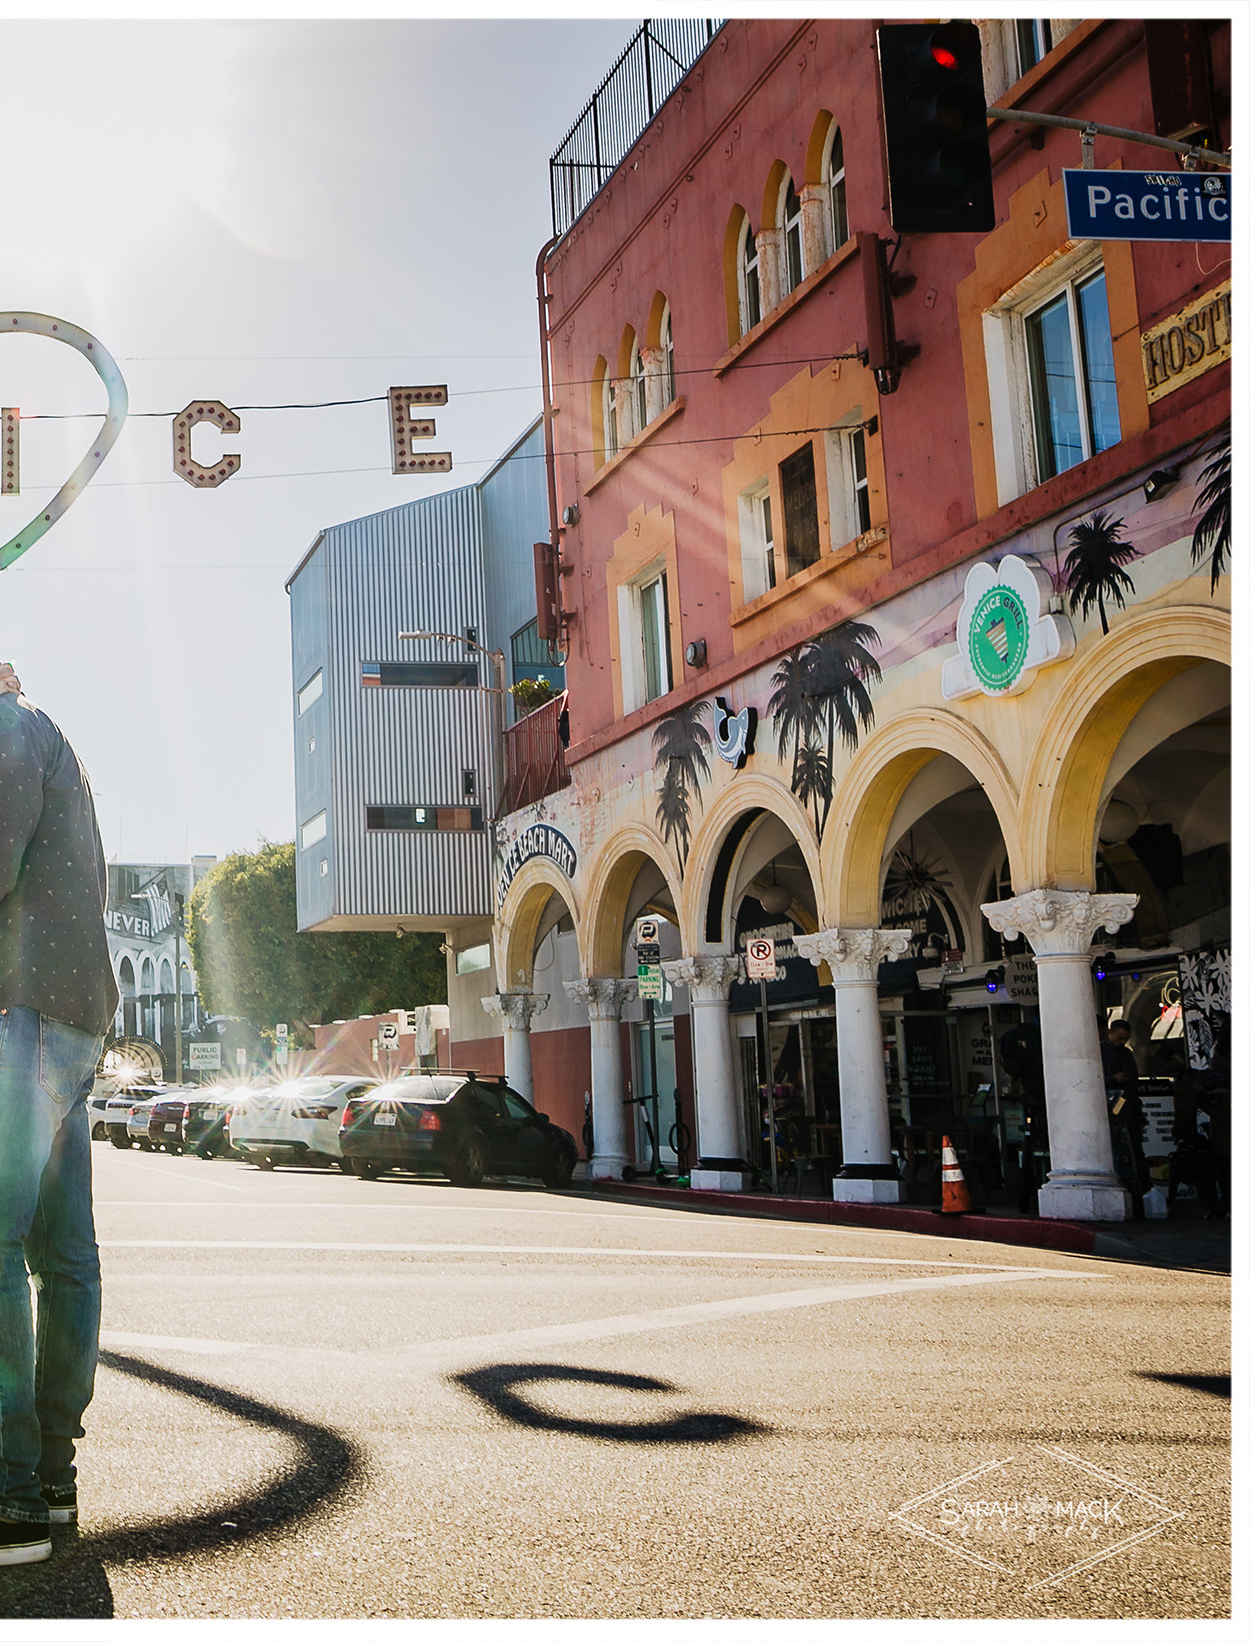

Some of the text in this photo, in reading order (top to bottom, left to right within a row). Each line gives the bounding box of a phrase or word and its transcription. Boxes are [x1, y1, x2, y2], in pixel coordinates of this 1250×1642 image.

[1087, 184, 1229, 222] Pacific
[1143, 292, 1232, 391] HOST
[973, 595, 1024, 633] VENICE GRILL
[517, 827, 545, 862] BEACH
[548, 830, 575, 877] MART
[103, 909, 151, 937] NEVER
[1015, 961, 1036, 971] THE
